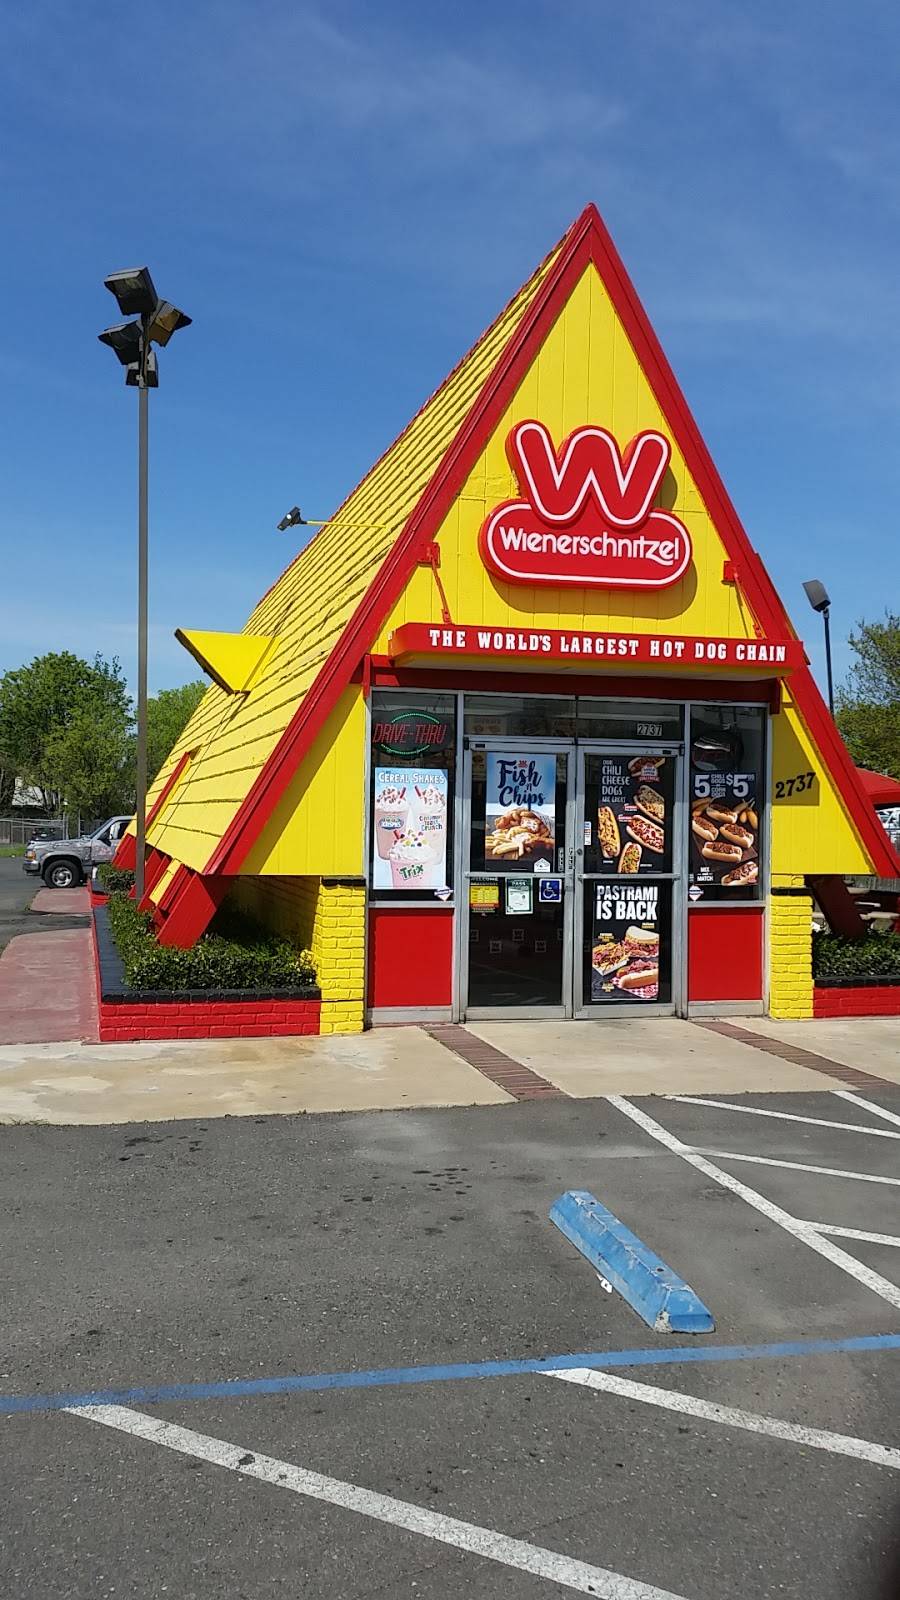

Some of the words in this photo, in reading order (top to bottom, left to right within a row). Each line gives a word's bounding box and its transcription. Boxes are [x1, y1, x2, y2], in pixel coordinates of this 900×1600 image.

[498, 525, 680, 566] Wienerschnitzel
[429, 629, 466, 648] THE
[477, 631, 552, 652] WORLD'S
[559, 635, 639, 656] LARGEST
[649, 638, 685, 658] HOT
[694, 641, 727, 660] DOG
[735, 643, 786, 662] CHAIN
[372, 723, 448, 744] DRIVE-THRU
[636, 722, 663, 737] 2737
[496, 759, 543, 788] Fish
[601, 775, 630, 786] CHEESE
[601, 785, 623, 796] DOGS
[694, 774, 711, 798] 5
[775, 772, 816, 799] 2737
[499, 785, 546, 811] Chips
[399, 864, 424, 880] Trix
[596, 885, 658, 901] PASTRAMI
[596, 900, 613, 920] IS
[615, 901, 658, 920] BACK
